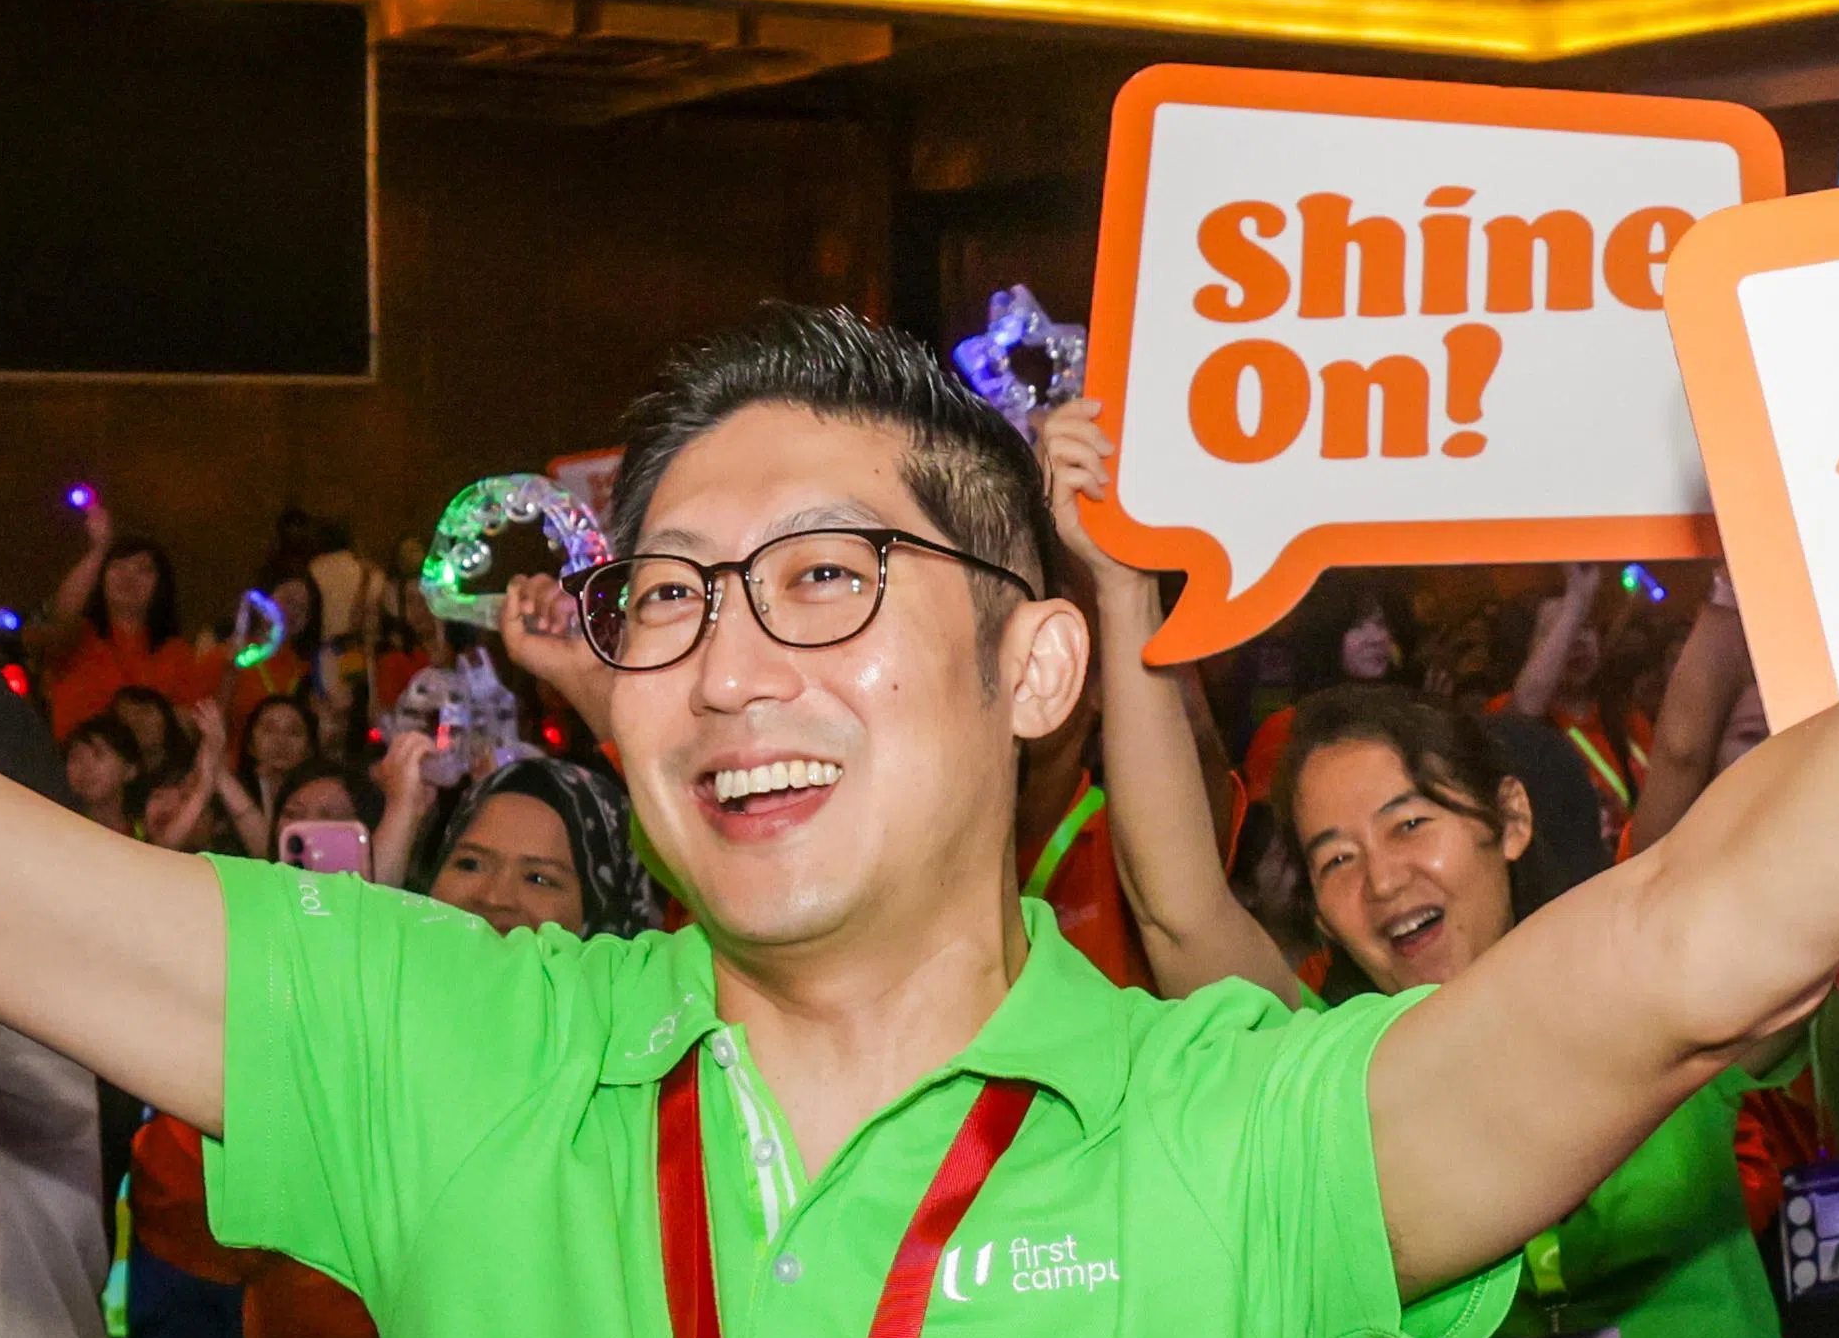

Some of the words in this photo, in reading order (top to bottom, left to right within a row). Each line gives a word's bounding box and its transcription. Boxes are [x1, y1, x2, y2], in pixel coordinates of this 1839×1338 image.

[1192, 184, 1697, 324] Shine
[1187, 322, 1504, 465] On!
[1009, 1234, 1077, 1270] first
